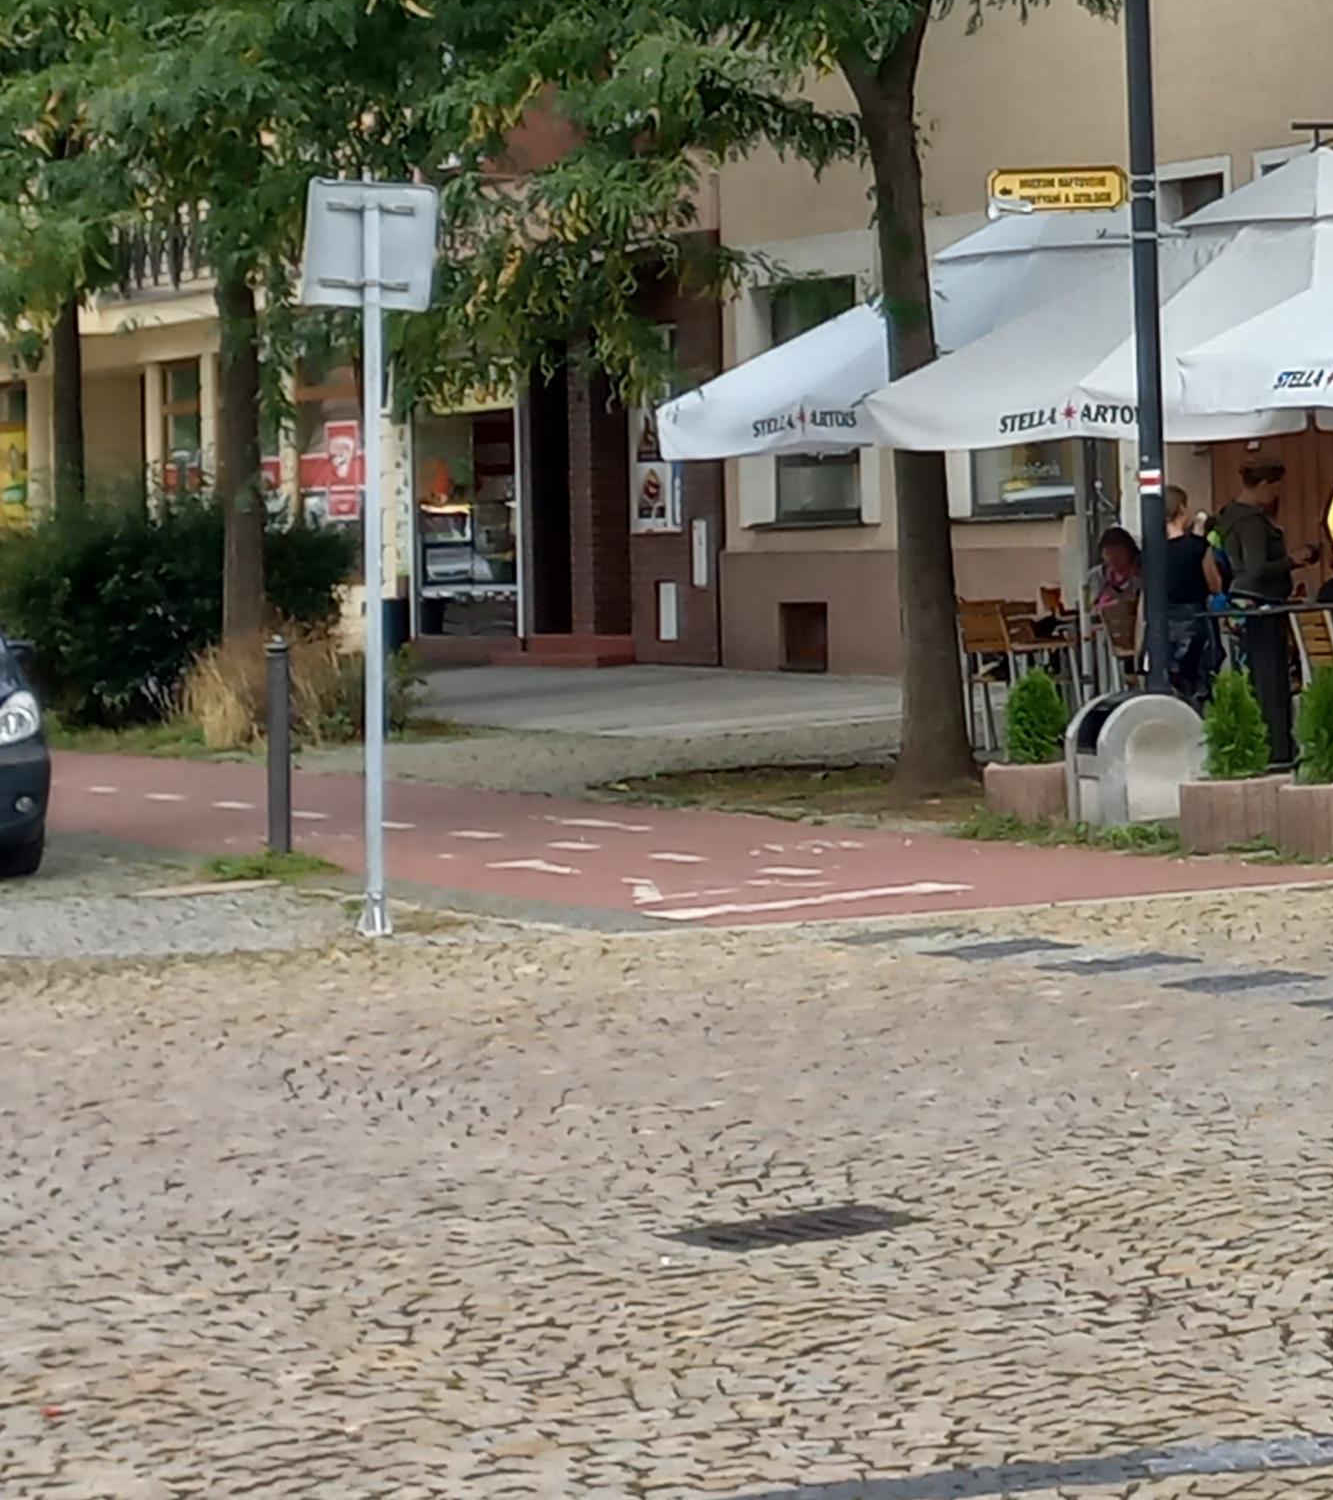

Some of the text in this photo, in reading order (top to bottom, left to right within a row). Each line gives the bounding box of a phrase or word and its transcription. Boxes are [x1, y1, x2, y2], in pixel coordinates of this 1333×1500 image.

[1272, 368, 1325, 390] STELLA
[751, 408, 857, 438] STELLA ARTOIS
[999, 408, 1058, 434] STELLA
